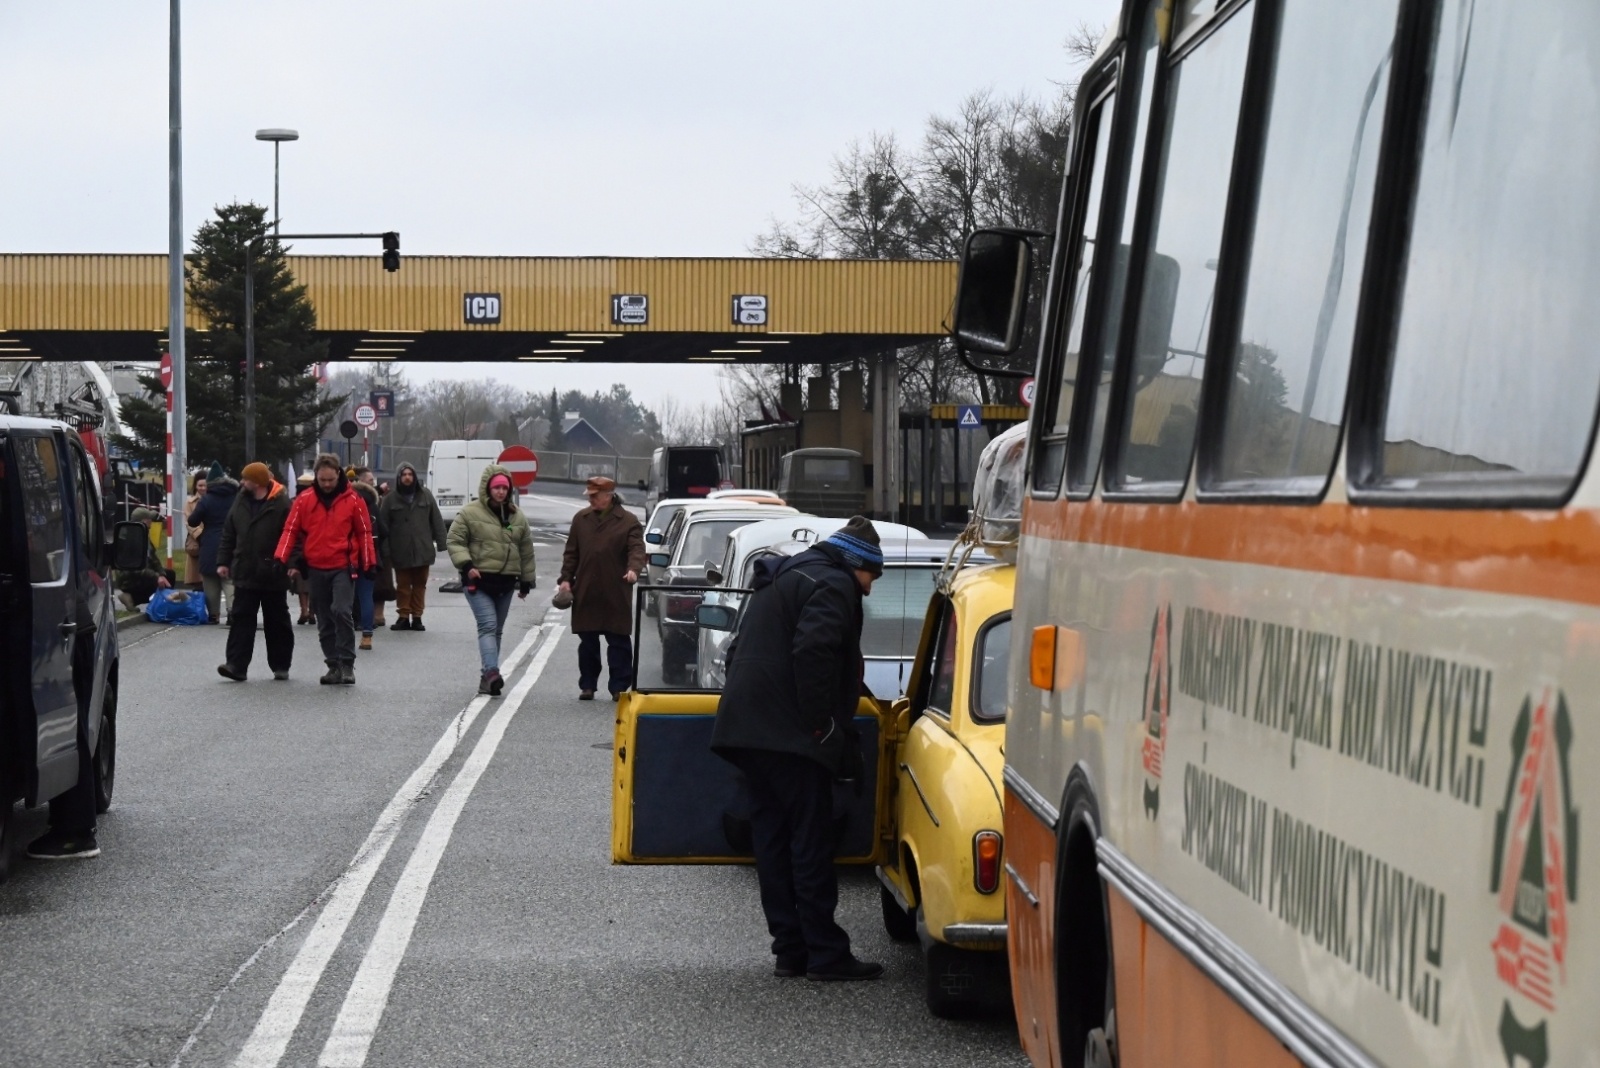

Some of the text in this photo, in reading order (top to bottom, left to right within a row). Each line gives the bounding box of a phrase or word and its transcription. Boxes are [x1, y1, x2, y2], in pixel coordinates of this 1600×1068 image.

[472, 297, 499, 318] CD
[1254, 622, 1341, 770] ZWIĄZEK
[1339, 638, 1493, 808] ROLNICZYCH
[1269, 807, 1446, 1027] PRODUKCYJNYCH
